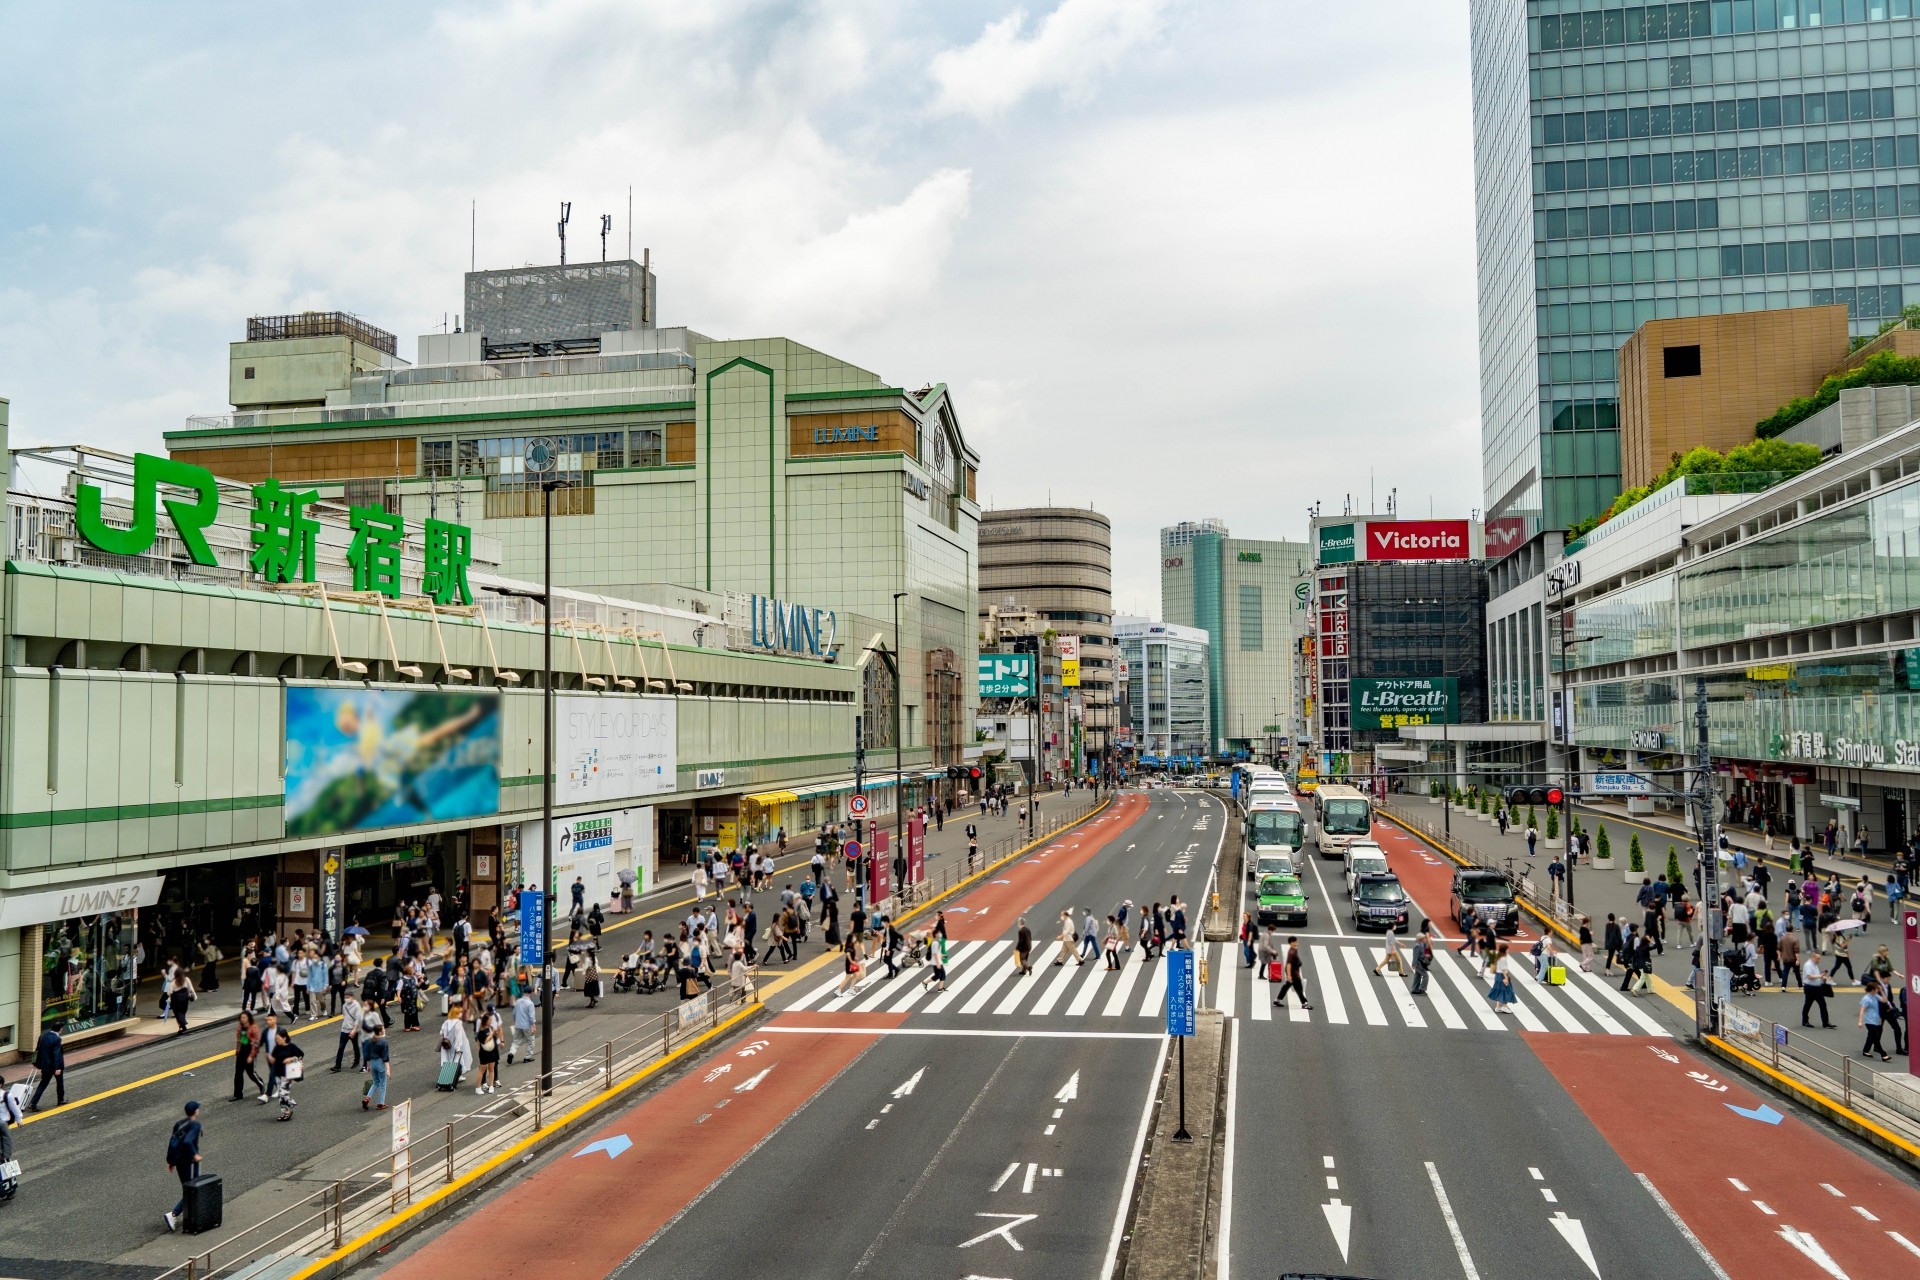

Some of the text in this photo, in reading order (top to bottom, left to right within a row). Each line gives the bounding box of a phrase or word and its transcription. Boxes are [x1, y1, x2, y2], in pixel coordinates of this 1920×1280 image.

[814, 425, 879, 444] LUMINE
[76, 453, 474, 607] JR 新宿駅
[1321, 537, 1354, 547] L-Breath
[1374, 531, 1461, 550] Victoria
[752, 594, 837, 657] LUMINE 2
[979, 659, 1028, 680] ニトリ
[979, 684, 1009, 694] 徒歩2分
[1376, 680, 1431, 689] アウトドア用品
[1361, 690, 1448, 706] L-Breath
[569, 712, 668, 739] STYLE YOUR DAYS
[1380, 714, 1430, 728] 営業中!
[1791, 731, 1826, 758] 新宿駅
[1836, 738, 1884, 767] Shinjuku
[1595, 775, 1646, 784] 新宿駅南口
[579, 818, 611, 830] みどりの窓口
[578, 828, 611, 841] きっぷうりば
[580, 837, 611, 850] VIEW ALTTE
[59, 885, 140, 916] LUMINE 2
[1170, 996, 1178, 1032] 入れません
